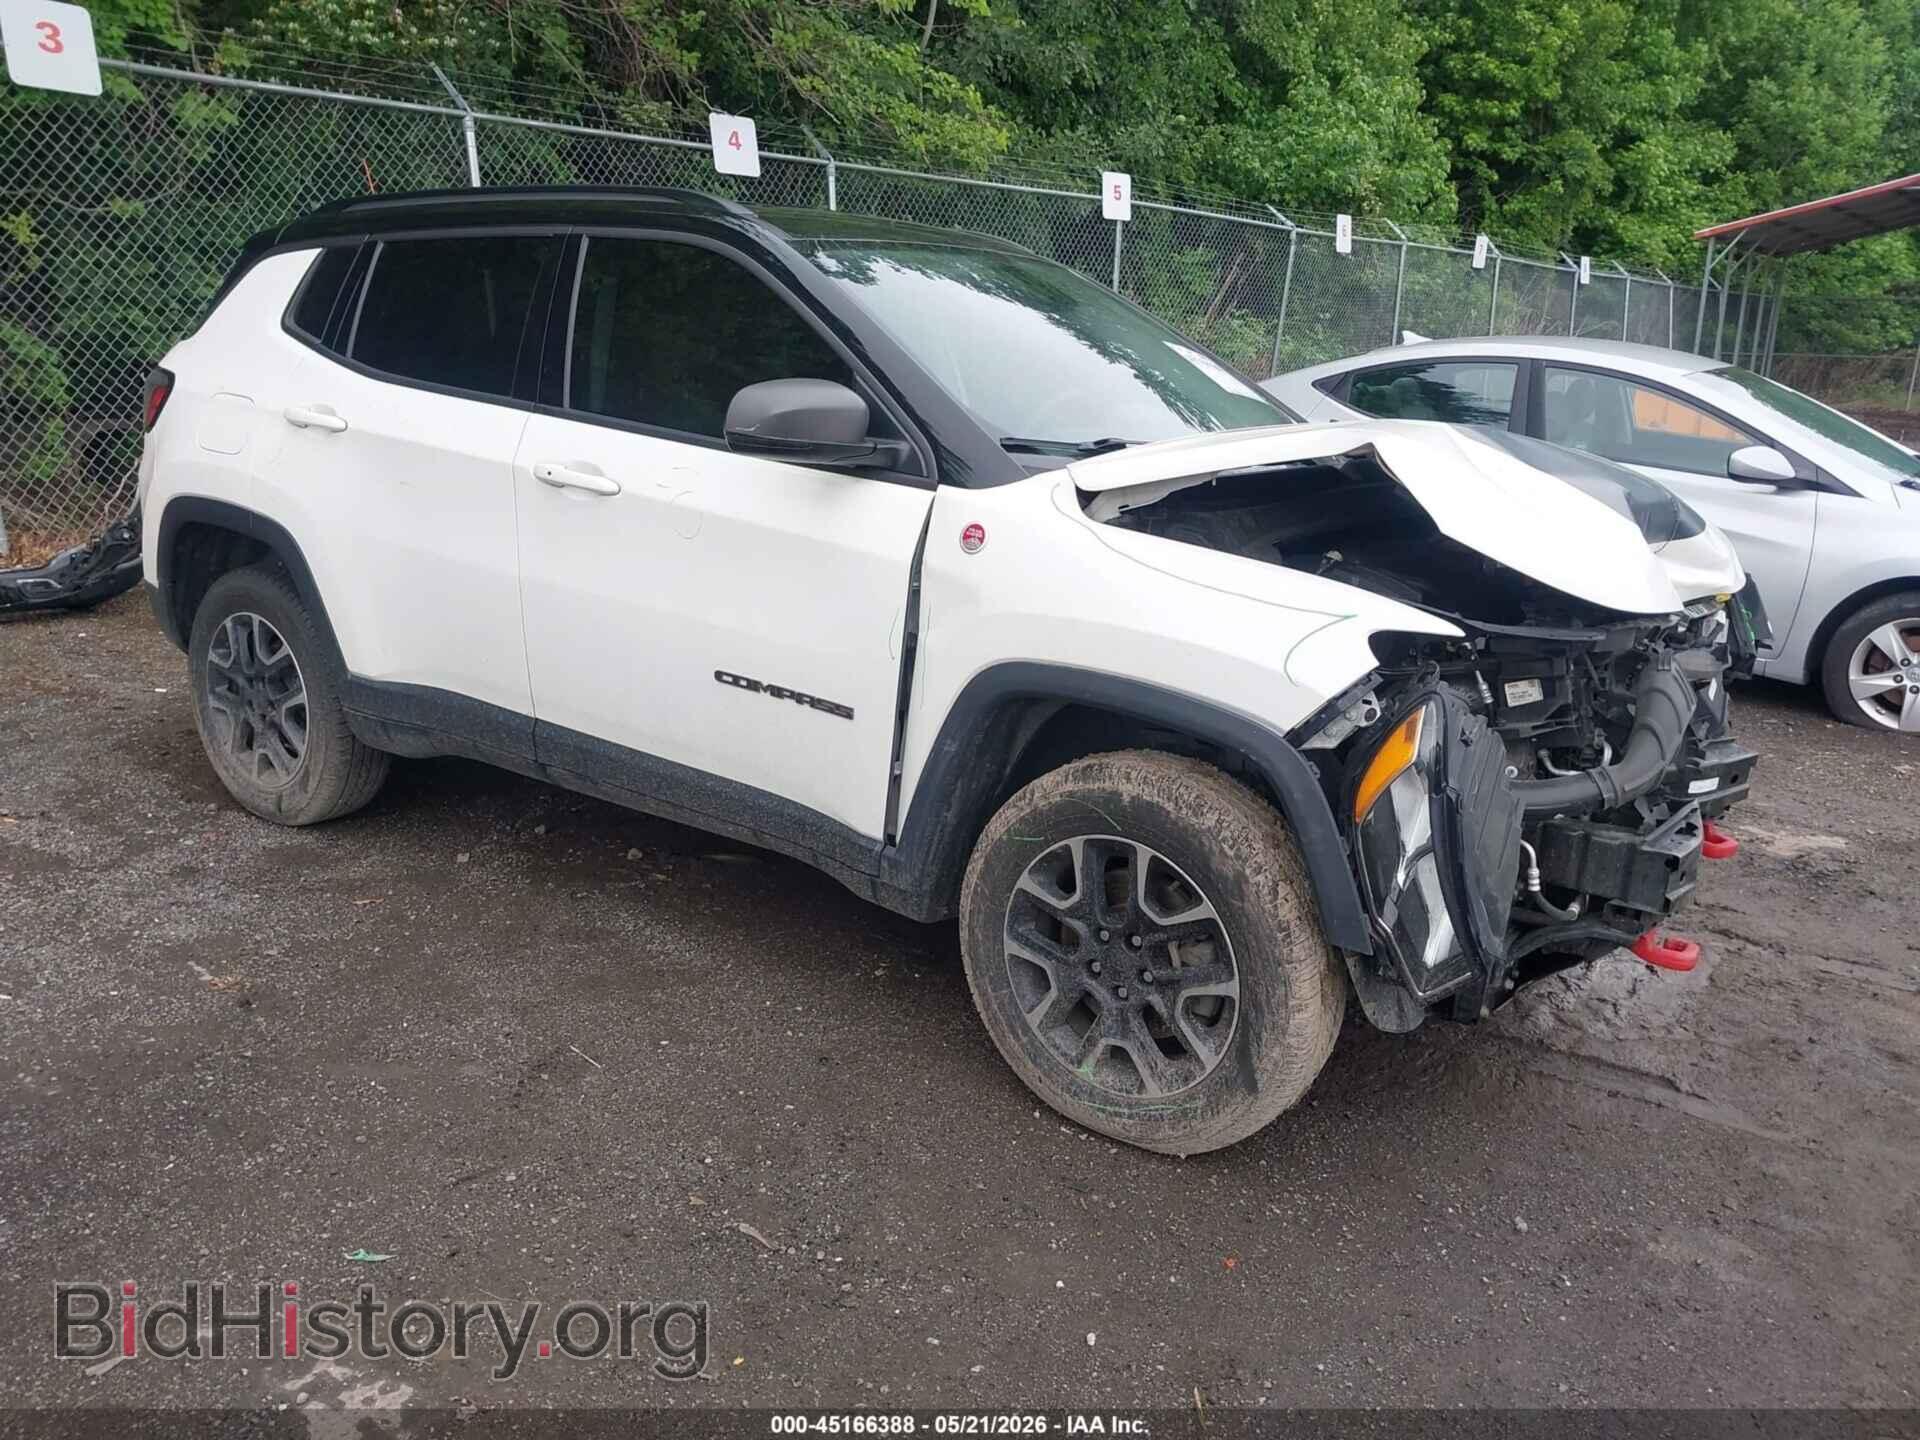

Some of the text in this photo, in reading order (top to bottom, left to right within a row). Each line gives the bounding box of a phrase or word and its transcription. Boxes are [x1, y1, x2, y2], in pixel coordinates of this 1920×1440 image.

[35, 21, 64, 54] 3
[728, 130, 742, 151] 4
[1113, 184, 1122, 201] 5
[714, 669, 855, 720] COMPASS
